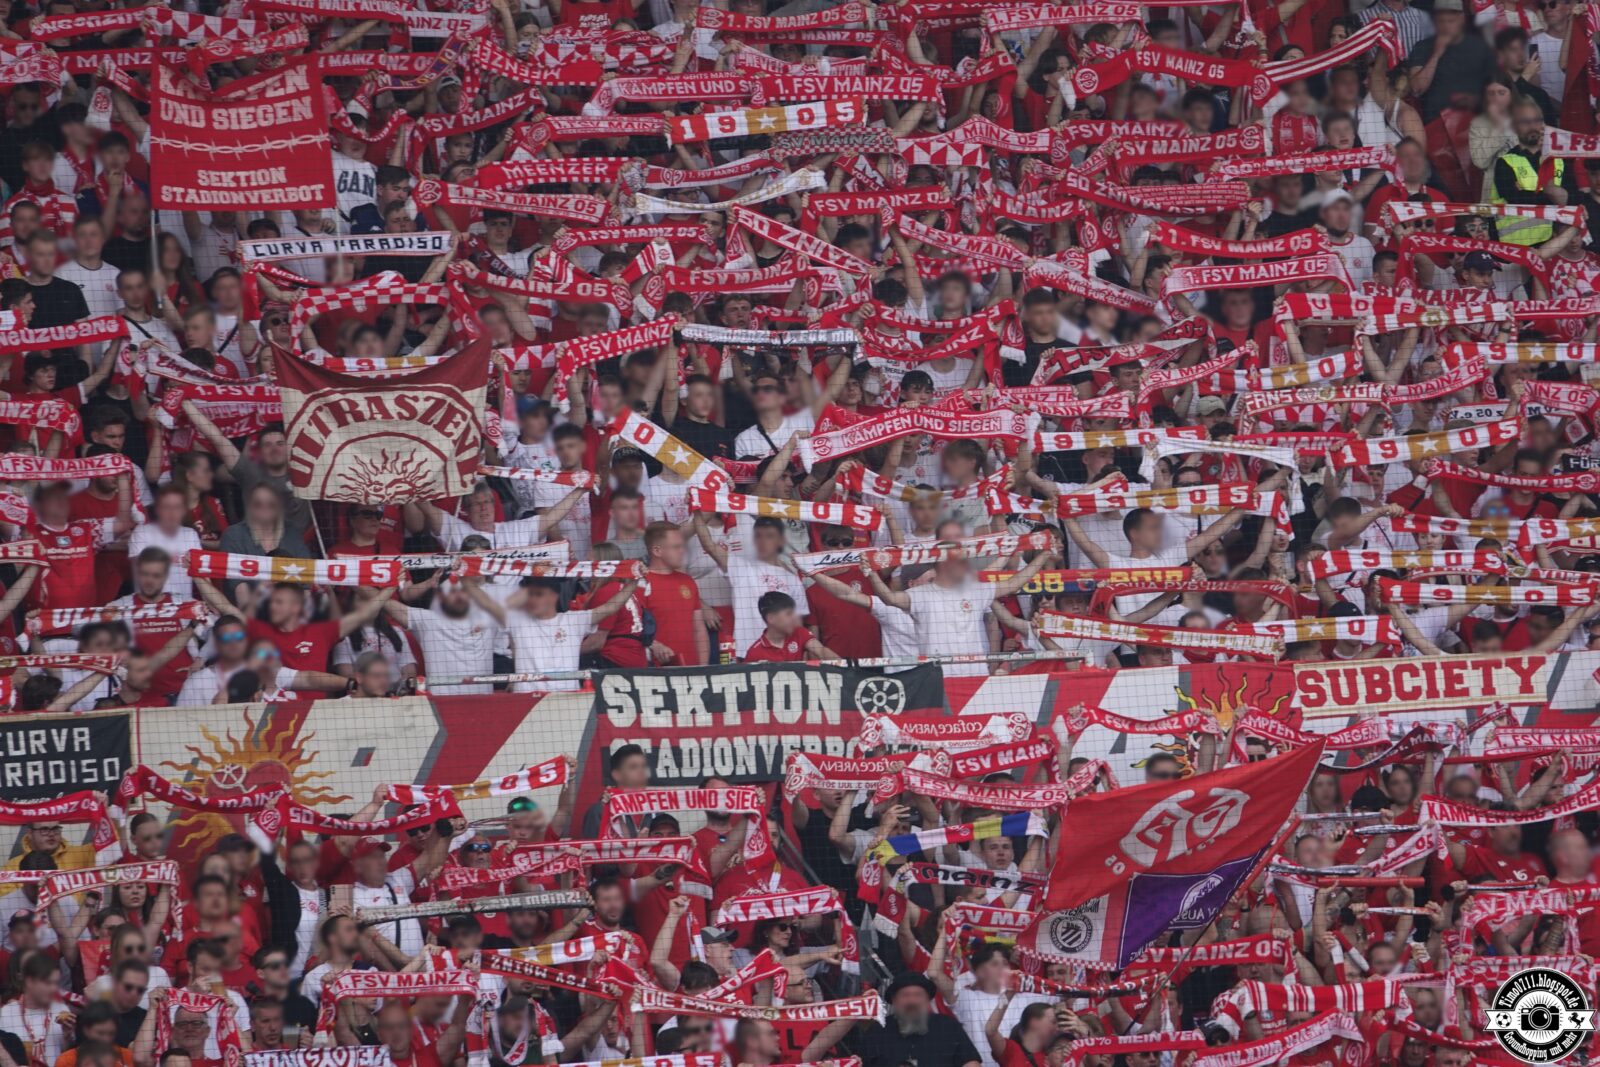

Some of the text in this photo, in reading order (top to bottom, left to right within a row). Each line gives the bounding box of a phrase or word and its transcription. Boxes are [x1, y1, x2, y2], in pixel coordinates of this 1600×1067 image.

[745, 14, 771, 28] FSV
[775, 11, 819, 28] MAINZ
[822, 8, 839, 22] 05
[1008, 8, 1047, 23] FSV
[1049, 5, 1109, 19] MAINZ
[1114, 4, 1138, 16] 05
[1135, 50, 1226, 79] FSV MAINZ 05
[701, 80, 729, 95] UND
[794, 76, 829, 93] FSV
[834, 76, 895, 93] MAINZ
[900, 76, 924, 93] 05
[160, 95, 315, 131] UND SIEGEN
[424, 96, 527, 134] FSV MAINZ
[1069, 121, 1177, 140] FSV MAINZ
[1114, 132, 1238, 160] FSV MAINZ 05
[197, 166, 288, 188] SEKTION
[503, 162, 609, 181] MEENZER
[160, 183, 326, 206] STADIONVERBOT
[512, 191, 571, 210] MAINZ
[574, 196, 598, 215] 05
[815, 192, 922, 212] FSV MAINZ
[623, 225, 698, 240] MAINZ 05
[922, 226, 962, 251] FSV
[253, 240, 324, 258] CURVA
[1190, 235, 1222, 251] FSV
[1227, 238, 1286, 254] MAINZ
[1290, 234, 1313, 251] 05
[690, 260, 794, 286] FSV MAINZ
[1202, 268, 1235, 284] FSV
[1239, 261, 1300, 281] MAINZ
[1304, 256, 1328, 273] 05
[487, 274, 608, 298] MAINZ 05
[582, 339, 611, 358] FSV
[616, 321, 672, 349] MAINZ
[1178, 352, 1234, 378] MAINZ
[1407, 355, 1487, 397] MAINZ 05
[913, 416, 945, 432] UND
[947, 417, 1002, 433] SIEGEN
[290, 393, 482, 489] ULTRASZENE
[12, 455, 105, 473] FSV MAINZ
[1296, 655, 1547, 708] SUBCIETY
[600, 670, 844, 729] SEKTION
[1104, 712, 1201, 733] FSV MAINZ 05
[1512, 734, 1544, 748] FSV
[956, 755, 993, 774] FSV
[685, 789, 720, 810] UND
[920, 776, 1067, 802] FSV MAINZ 05
[1256, 939, 1285, 958] 05
[351, 973, 391, 988] FSV
[395, 971, 460, 988] MAINZ
[641, 989, 676, 1009] DIE
[834, 999, 878, 1018] FSV
